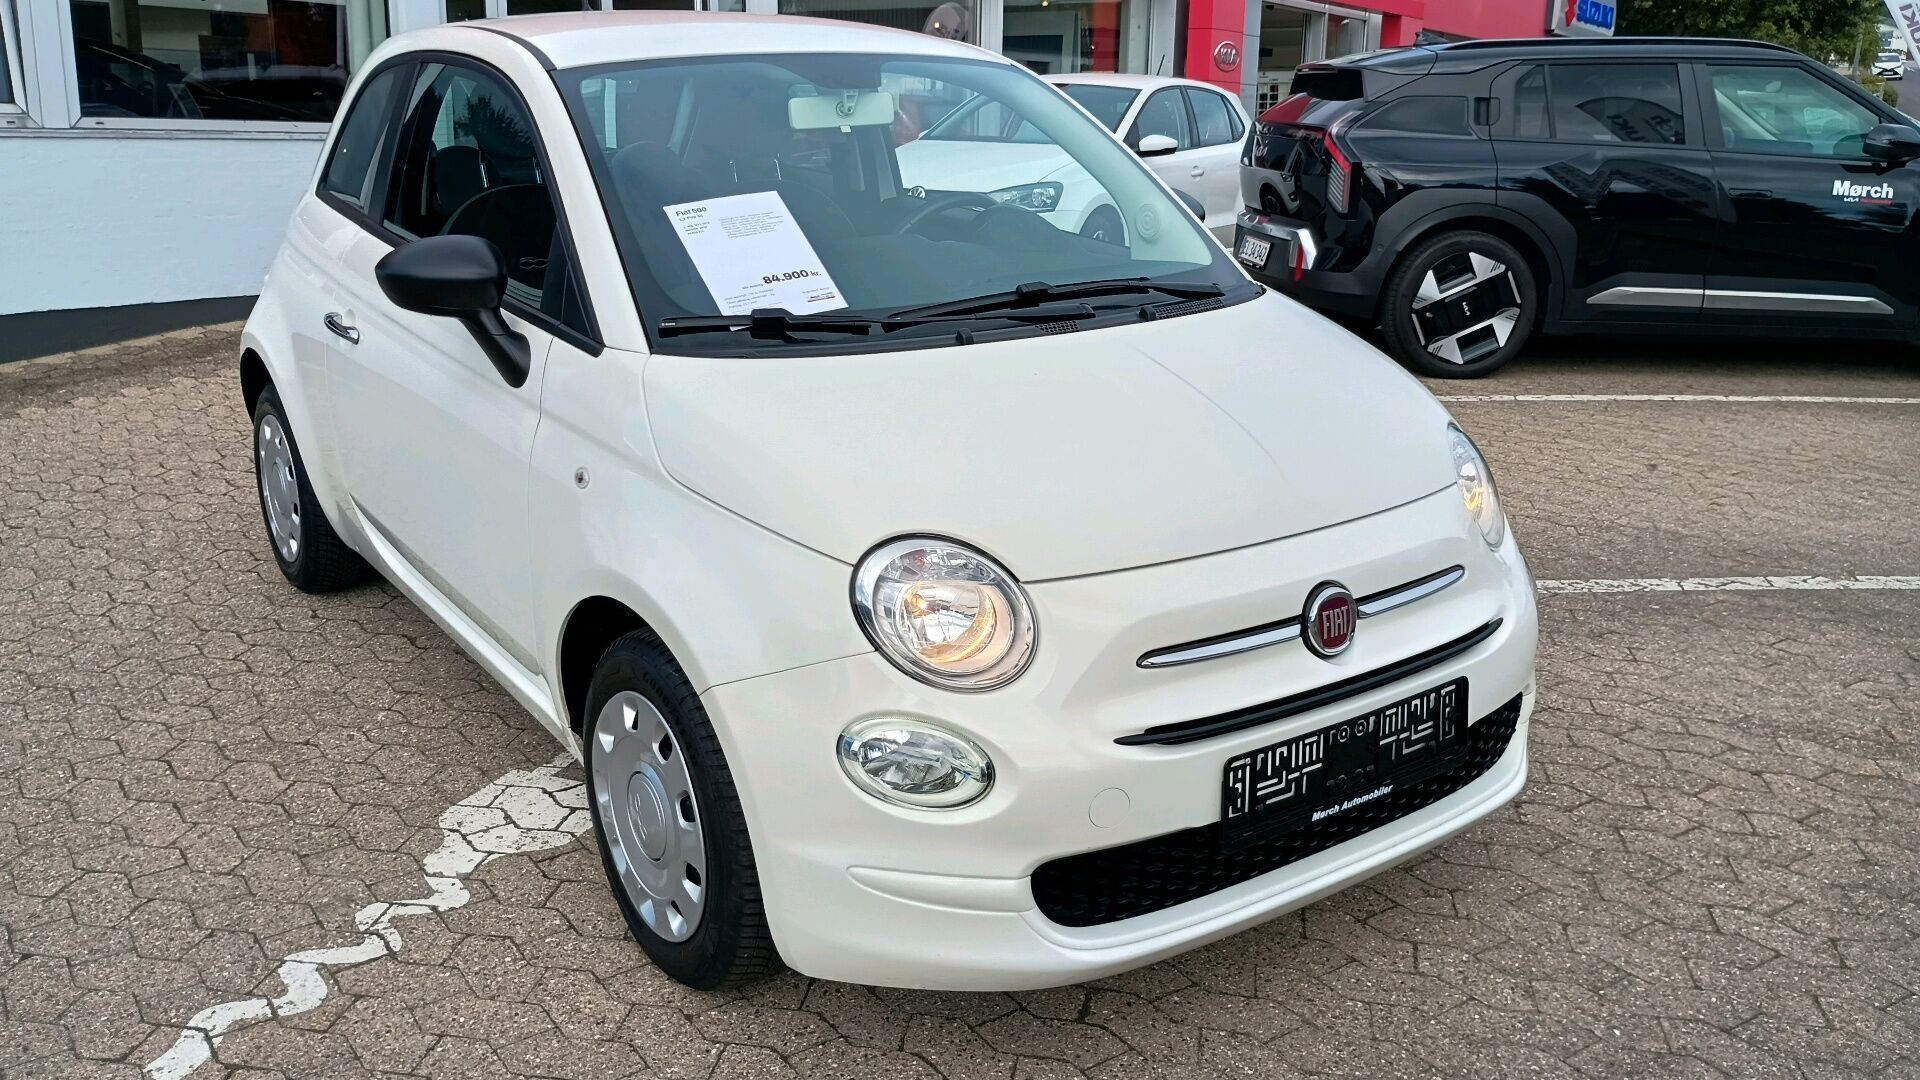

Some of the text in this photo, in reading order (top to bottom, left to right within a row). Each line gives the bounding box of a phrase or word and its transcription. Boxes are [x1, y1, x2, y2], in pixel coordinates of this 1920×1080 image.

[1832, 179, 1894, 199] Mørch
[675, 205, 707, 217] Fiat 500
[762, 269, 809, 285] 84.900
[1322, 605, 1349, 640] FIAT
[1341, 784, 1394, 811] Automobiler
